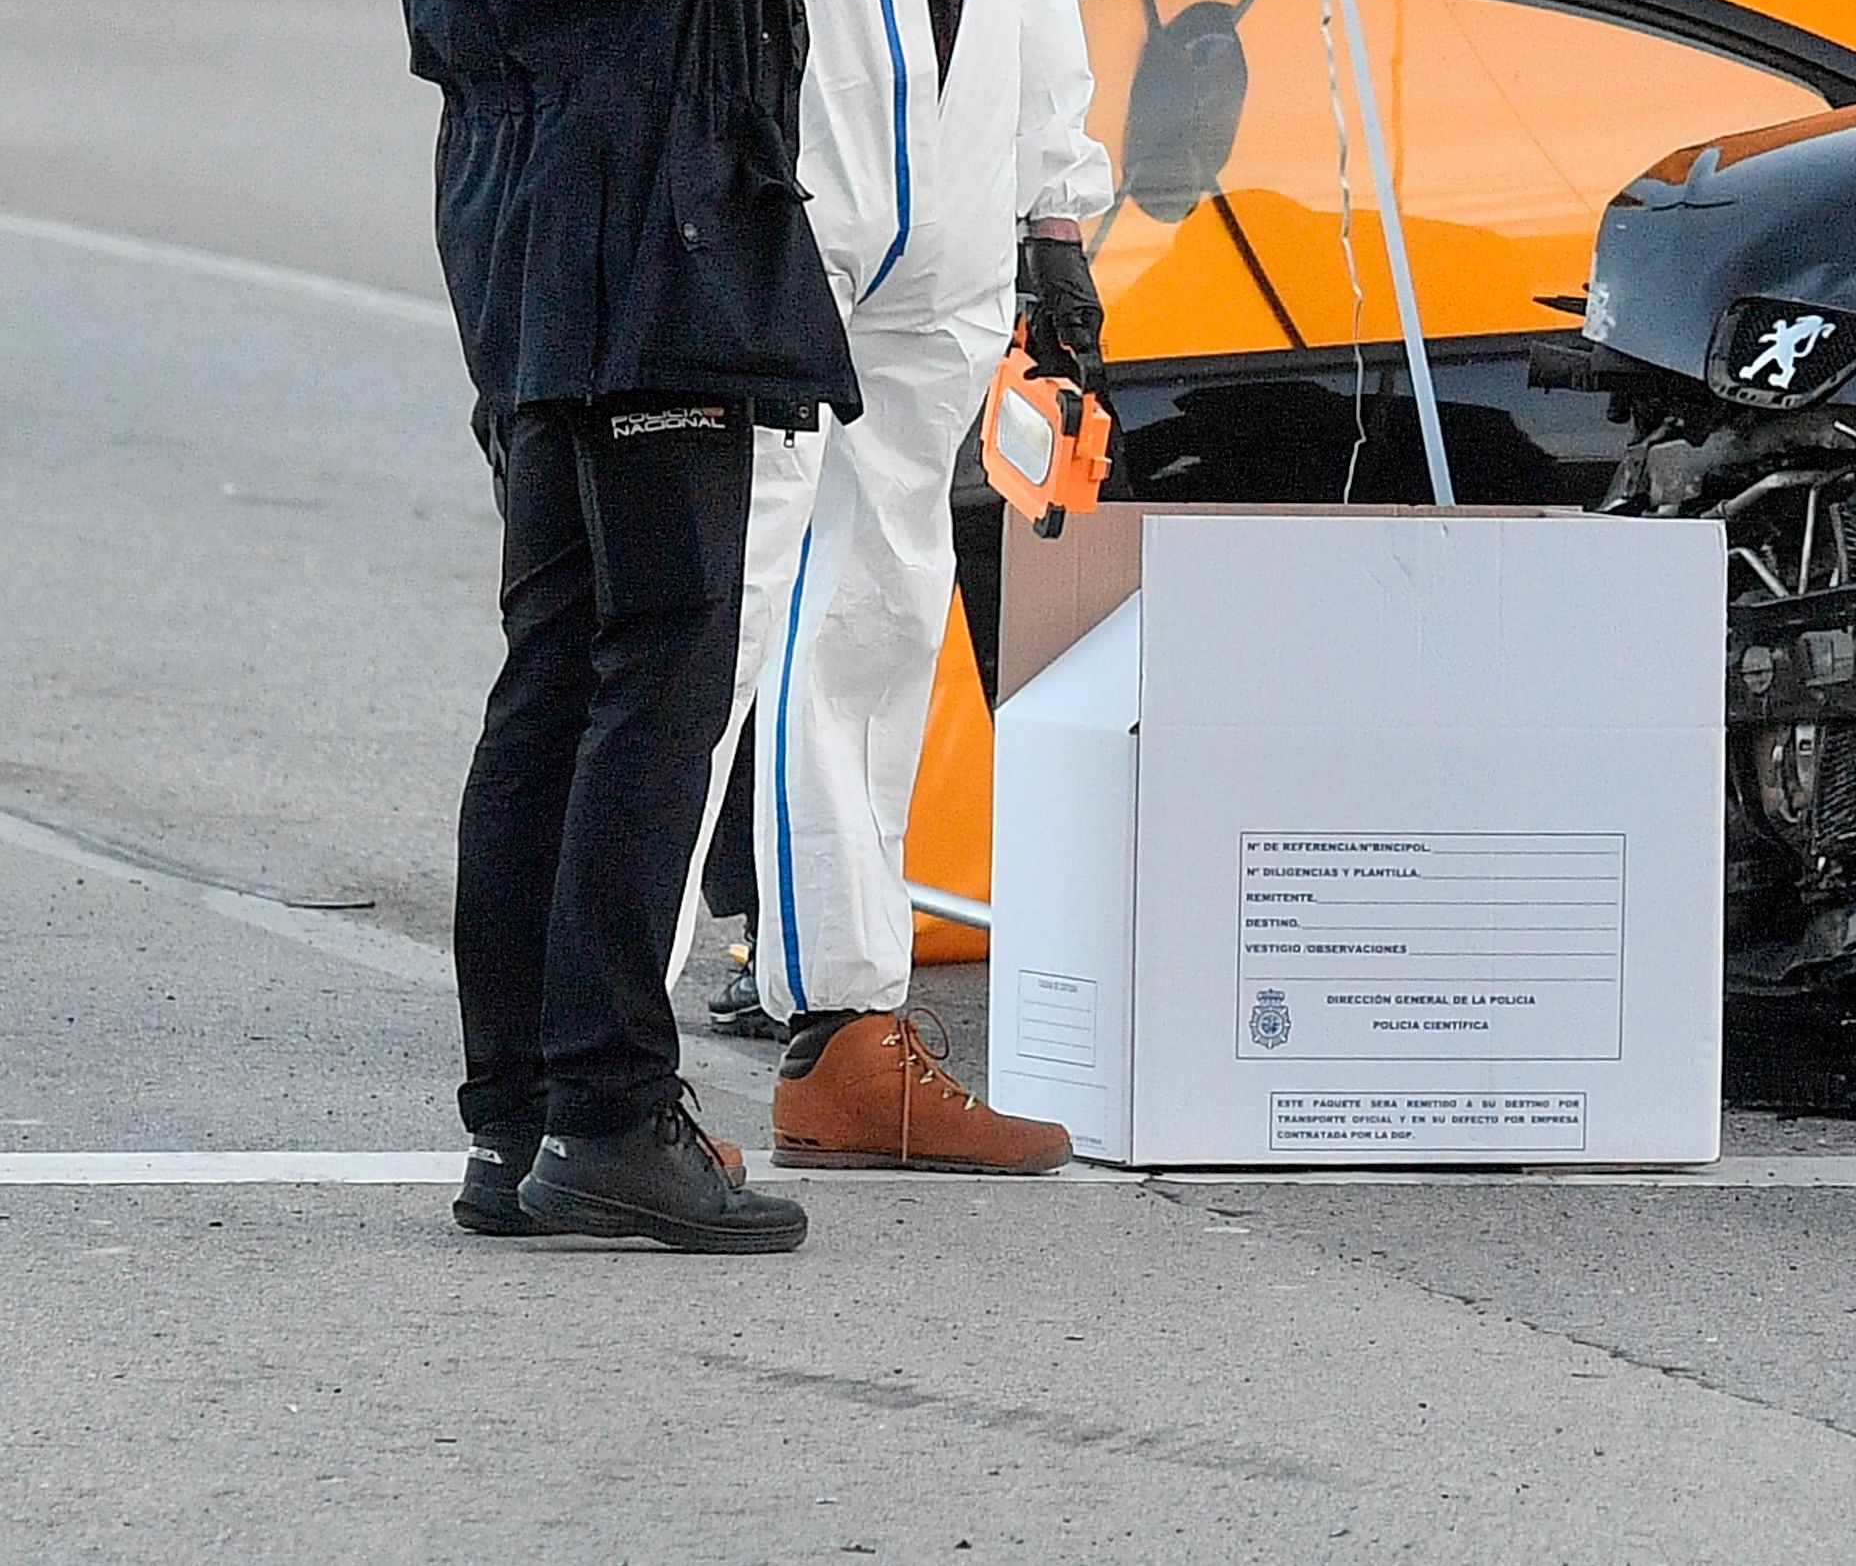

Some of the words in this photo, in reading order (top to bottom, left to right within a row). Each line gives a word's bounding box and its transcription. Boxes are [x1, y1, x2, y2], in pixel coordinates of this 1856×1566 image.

[611, 407, 703, 428] POLICIA
[613, 416, 727, 440] NACIONAL
[1263, 842, 1279, 852] DE
[1263, 867, 1339, 878] DILIGENCIAS
[1342, 868, 1350, 878] Y
[1245, 944, 1301, 954] VESTIGIO
[1394, 994, 1450, 1006] GENERAL
[1453, 995, 1469, 1006] DE
[1472, 995, 1487, 1006] LA
[1276, 1099, 1305, 1108] ESTE
[1312, 1099, 1362, 1109] PAQUETE
[1406, 1099, 1457, 1109] REMITIDO
[1465, 1099, 1474, 1108] A
[1481, 1099, 1497, 1108] SU
[1504, 1099, 1550, 1108] DESTINO
[1557, 1099, 1580, 1108] POR
[1277, 1115, 1347, 1124] TRANSPORTE
[1351, 1115, 1393, 1124] OFICIAL
[1399, 1115, 1406, 1124] Y
[1411, 1115, 1426, 1124] EN
[1451, 1115, 1499, 1124] DEFECTO
[1503, 1115, 1525, 1124] POR
[1530, 1115, 1579, 1124] EMPRESA
[1276, 1130, 1348, 1140] CONTRATADA
[1350, 1131, 1372, 1140] POR
[1374, 1131, 1388, 1140] LA
